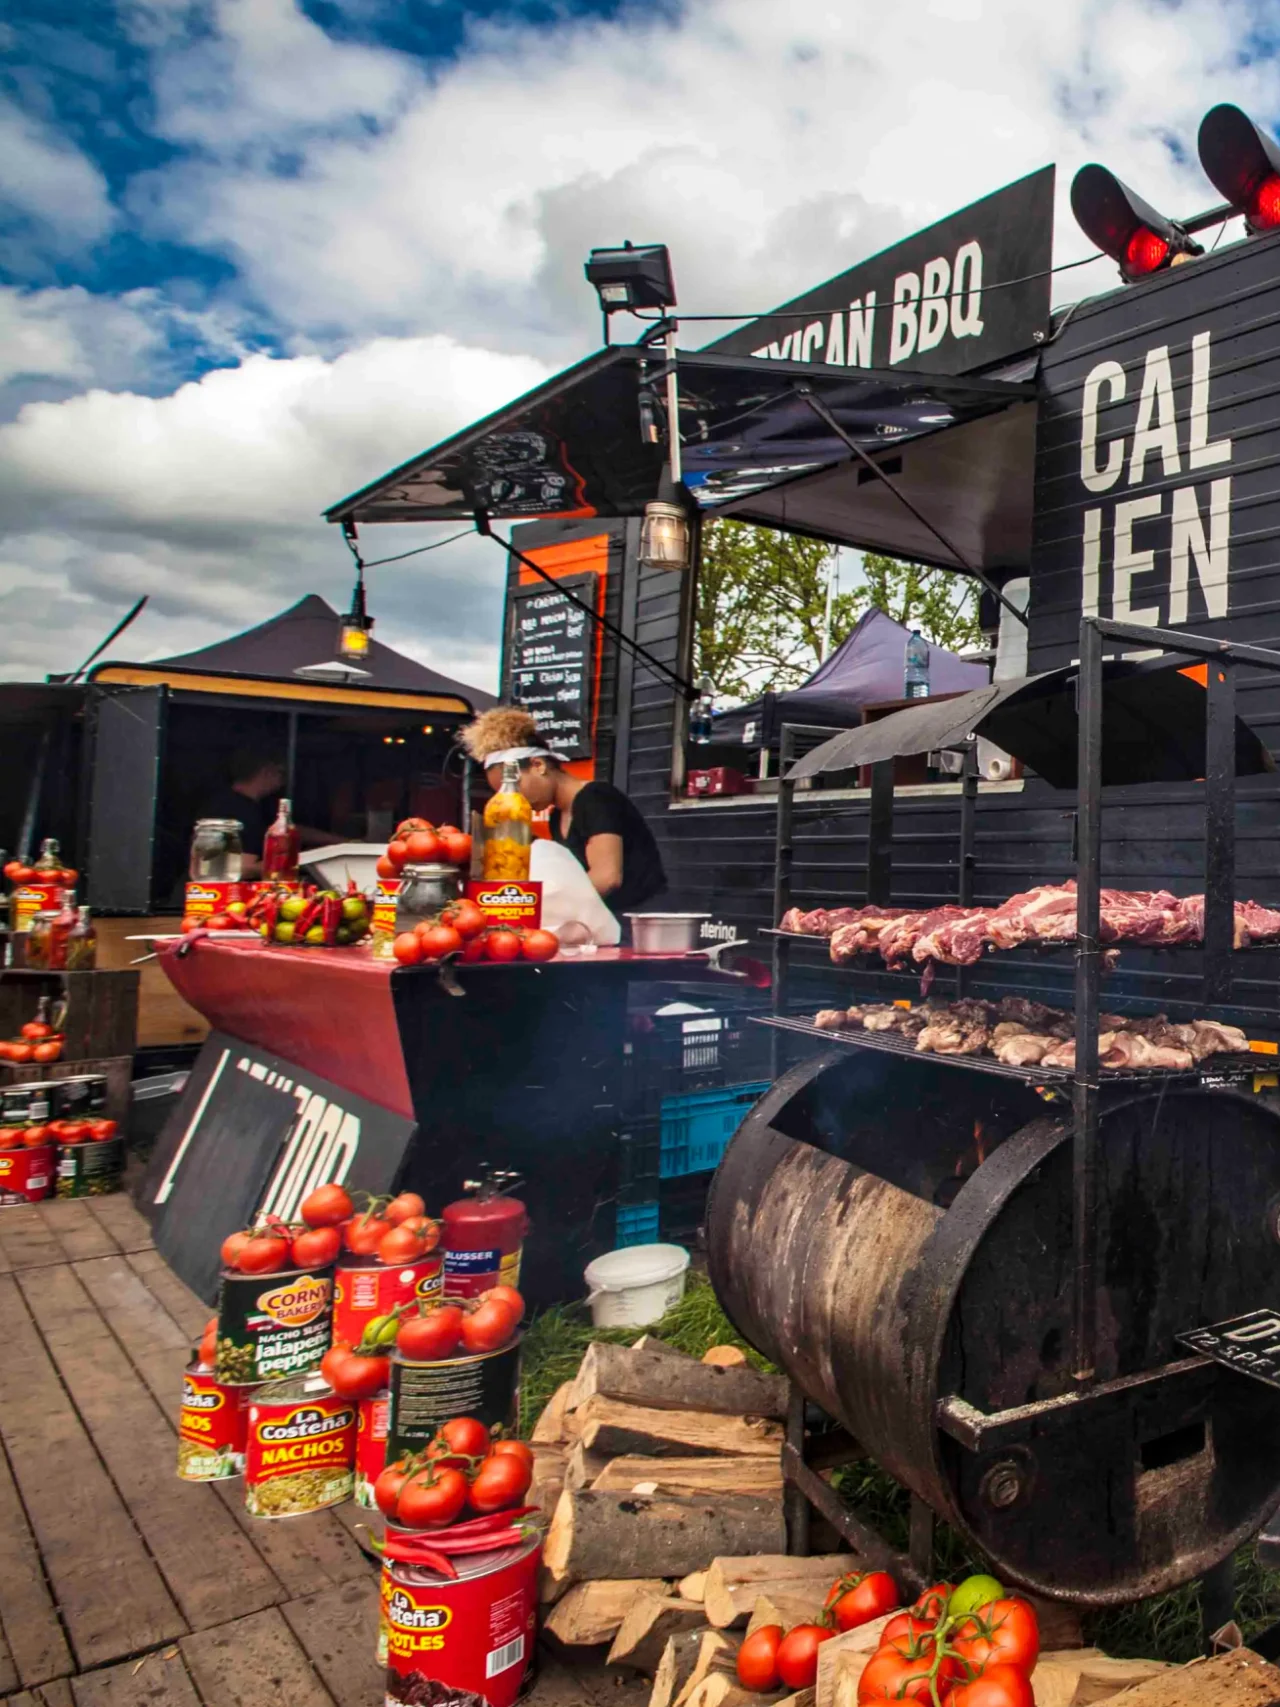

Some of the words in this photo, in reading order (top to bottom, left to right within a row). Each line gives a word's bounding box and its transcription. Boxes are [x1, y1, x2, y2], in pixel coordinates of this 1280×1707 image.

[889, 240, 985, 366] BBQ
[1080, 331, 1232, 493] CAL
[1082, 478, 1233, 628] IEN
[267, 1284, 329, 1310] CORNY
[276, 1300, 325, 1319] BAKER
[258, 1329, 301, 1344] NACHO
[262, 1413, 349, 1440] Costeña
[296, 1412, 319, 1425] La
[262, 1437, 345, 1465] NACHOS
[395, 1592, 408, 1609] La
